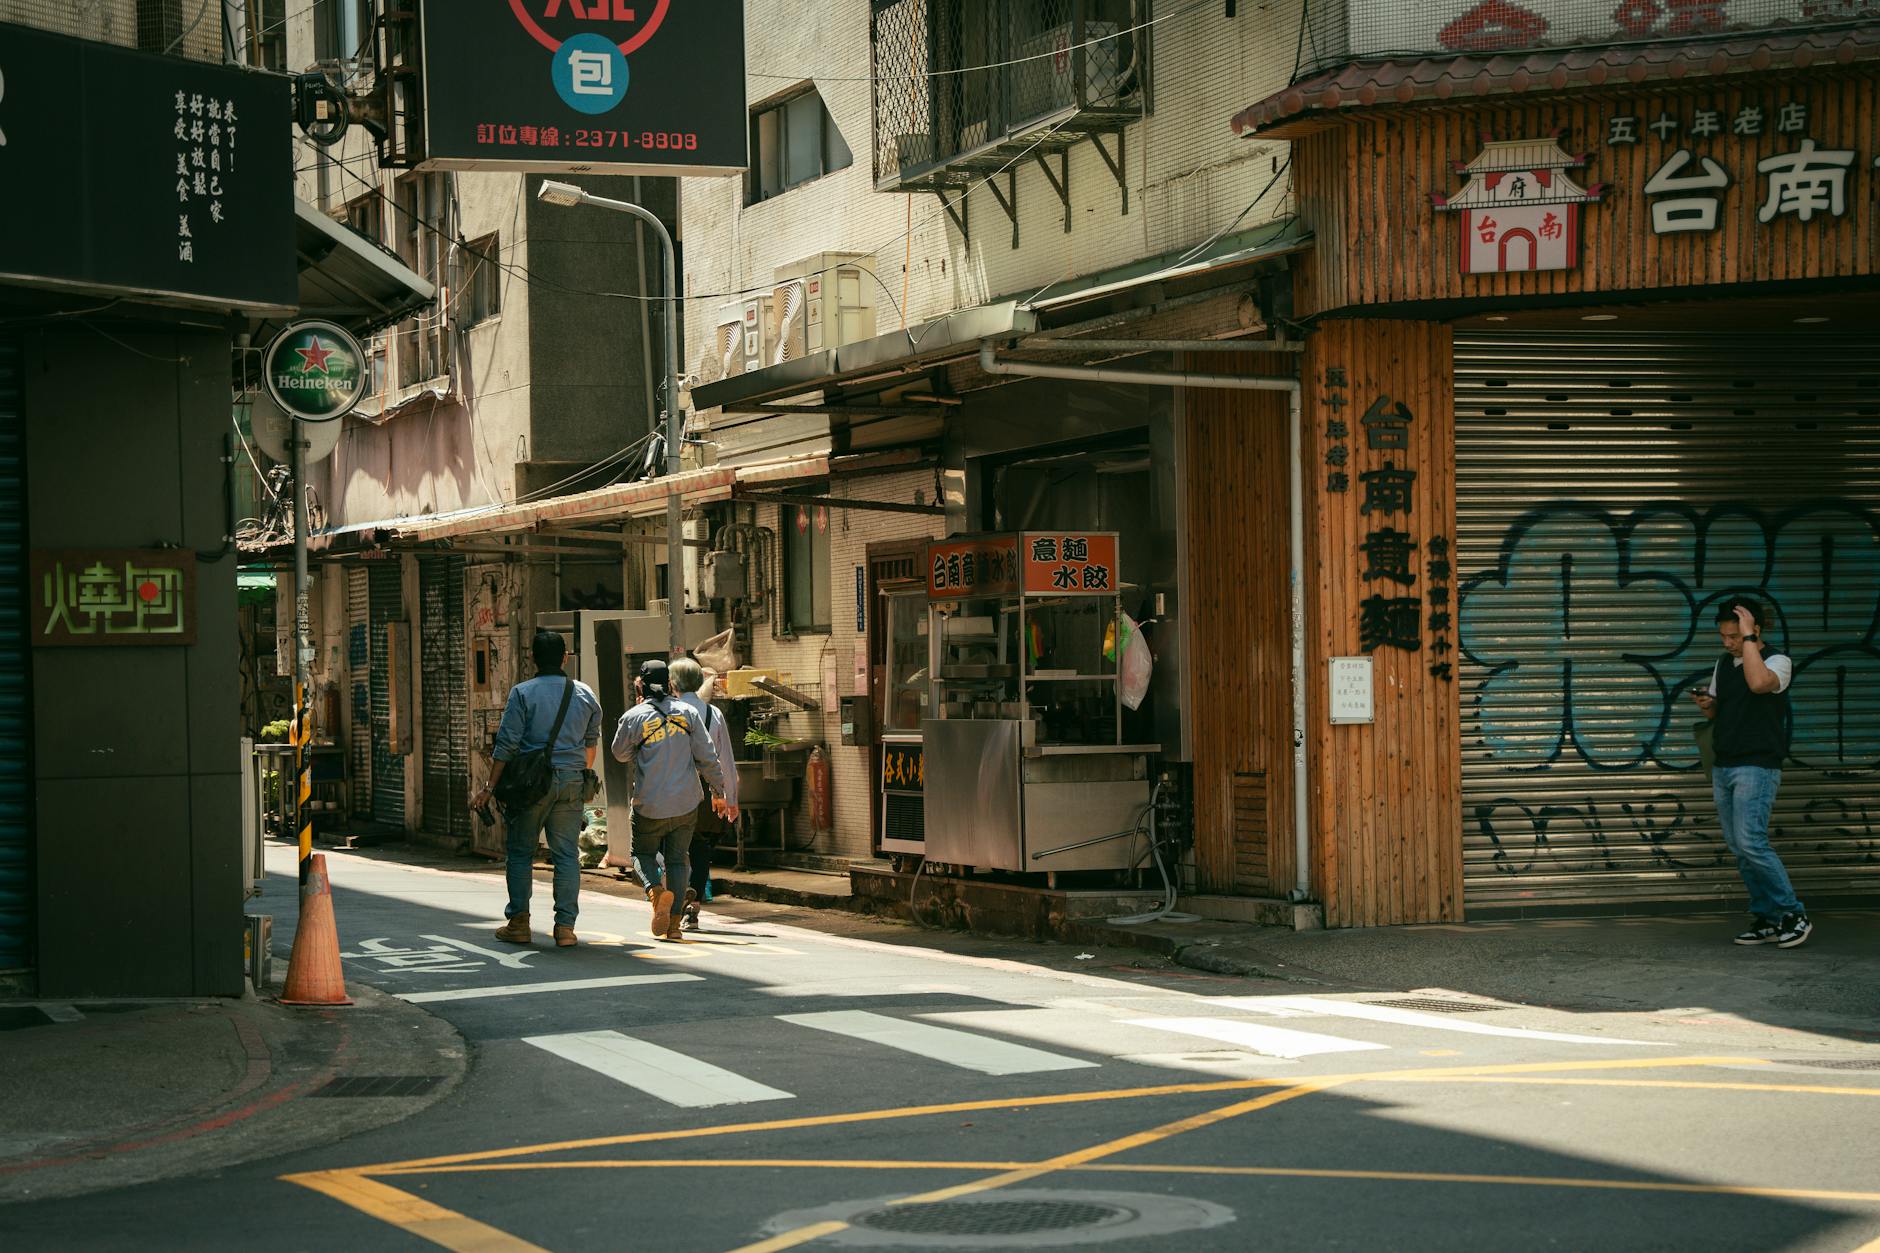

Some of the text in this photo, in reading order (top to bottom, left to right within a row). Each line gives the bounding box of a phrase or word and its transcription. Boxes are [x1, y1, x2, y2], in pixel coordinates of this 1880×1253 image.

[567, 49, 614, 95] 包
[189, 93, 207, 195] 好好放鬆
[223, 101, 238, 172] 來了!
[1607, 103, 1806, 144] 五十年老店
[174, 90, 193, 263] 享受 美食 美酒
[207, 98, 224, 223] 就當自己家
[1508, 176, 1527, 198] 府
[1644, 138, 1880, 234] 台南
[1477, 212, 1563, 244] 台南
[278, 375, 352, 390] Heineken
[1359, 395, 1422, 653] 台南意麵
[1032, 537, 1088, 562] 意麵
[1052, 564, 1108, 590] 水餃
